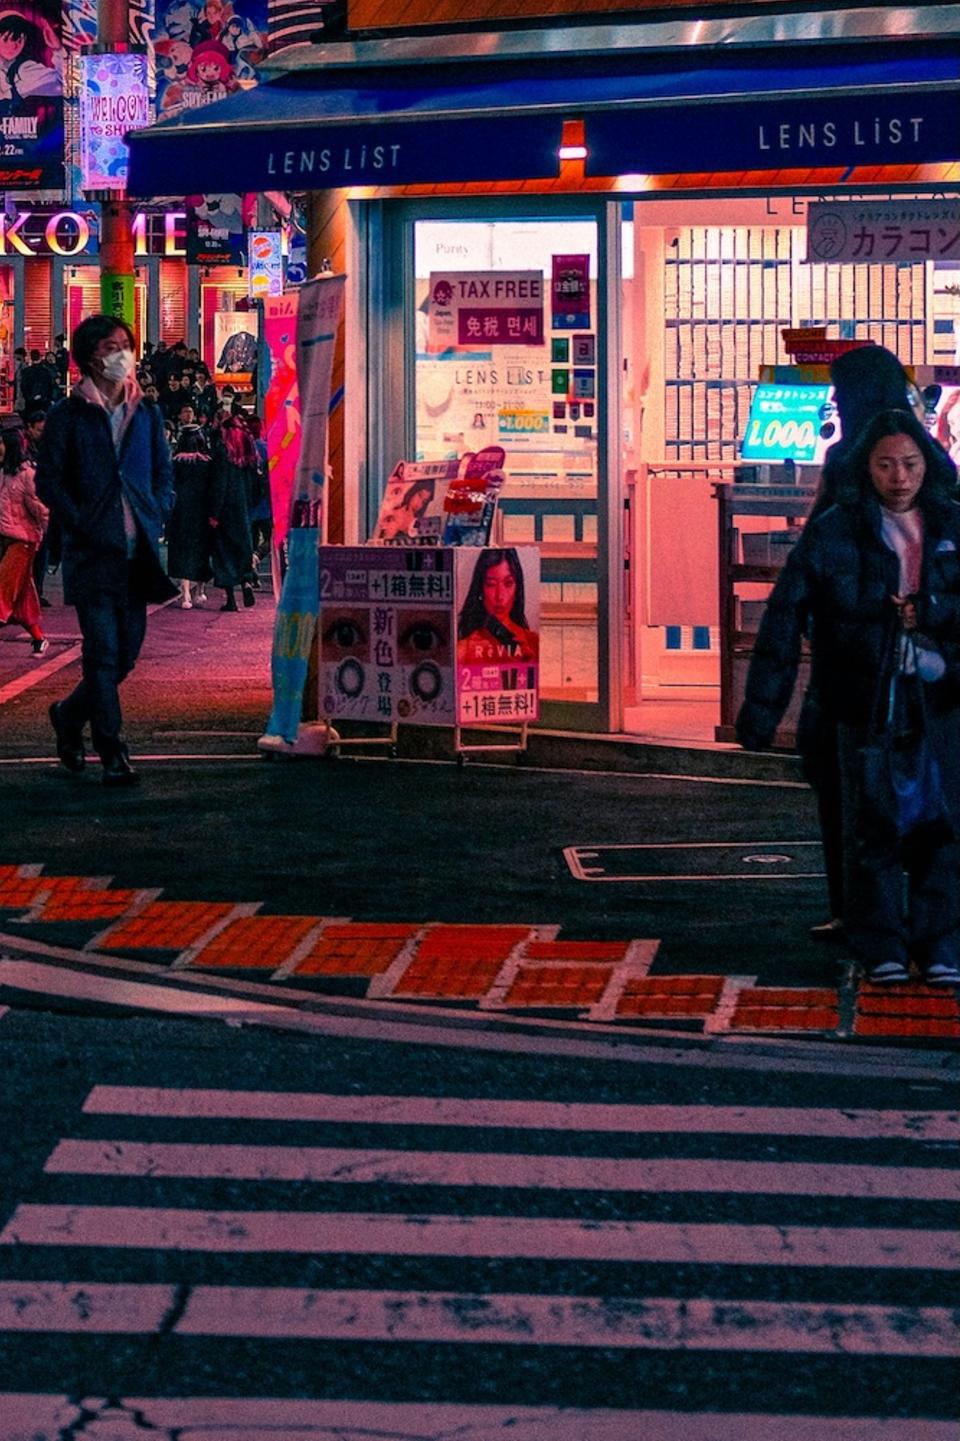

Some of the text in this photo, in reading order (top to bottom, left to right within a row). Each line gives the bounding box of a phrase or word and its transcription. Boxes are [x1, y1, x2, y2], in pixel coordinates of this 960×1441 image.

[759, 122, 837, 150] LENS
[268, 148, 331, 175] LENS
[852, 226, 960, 257] カラコン
[458, 280, 490, 298] TAX
[495, 279, 540, 298] FREE
[467, 315, 499, 337] 免税
[507, 315, 537, 337] 면세
[455, 369, 498, 385] LENS
